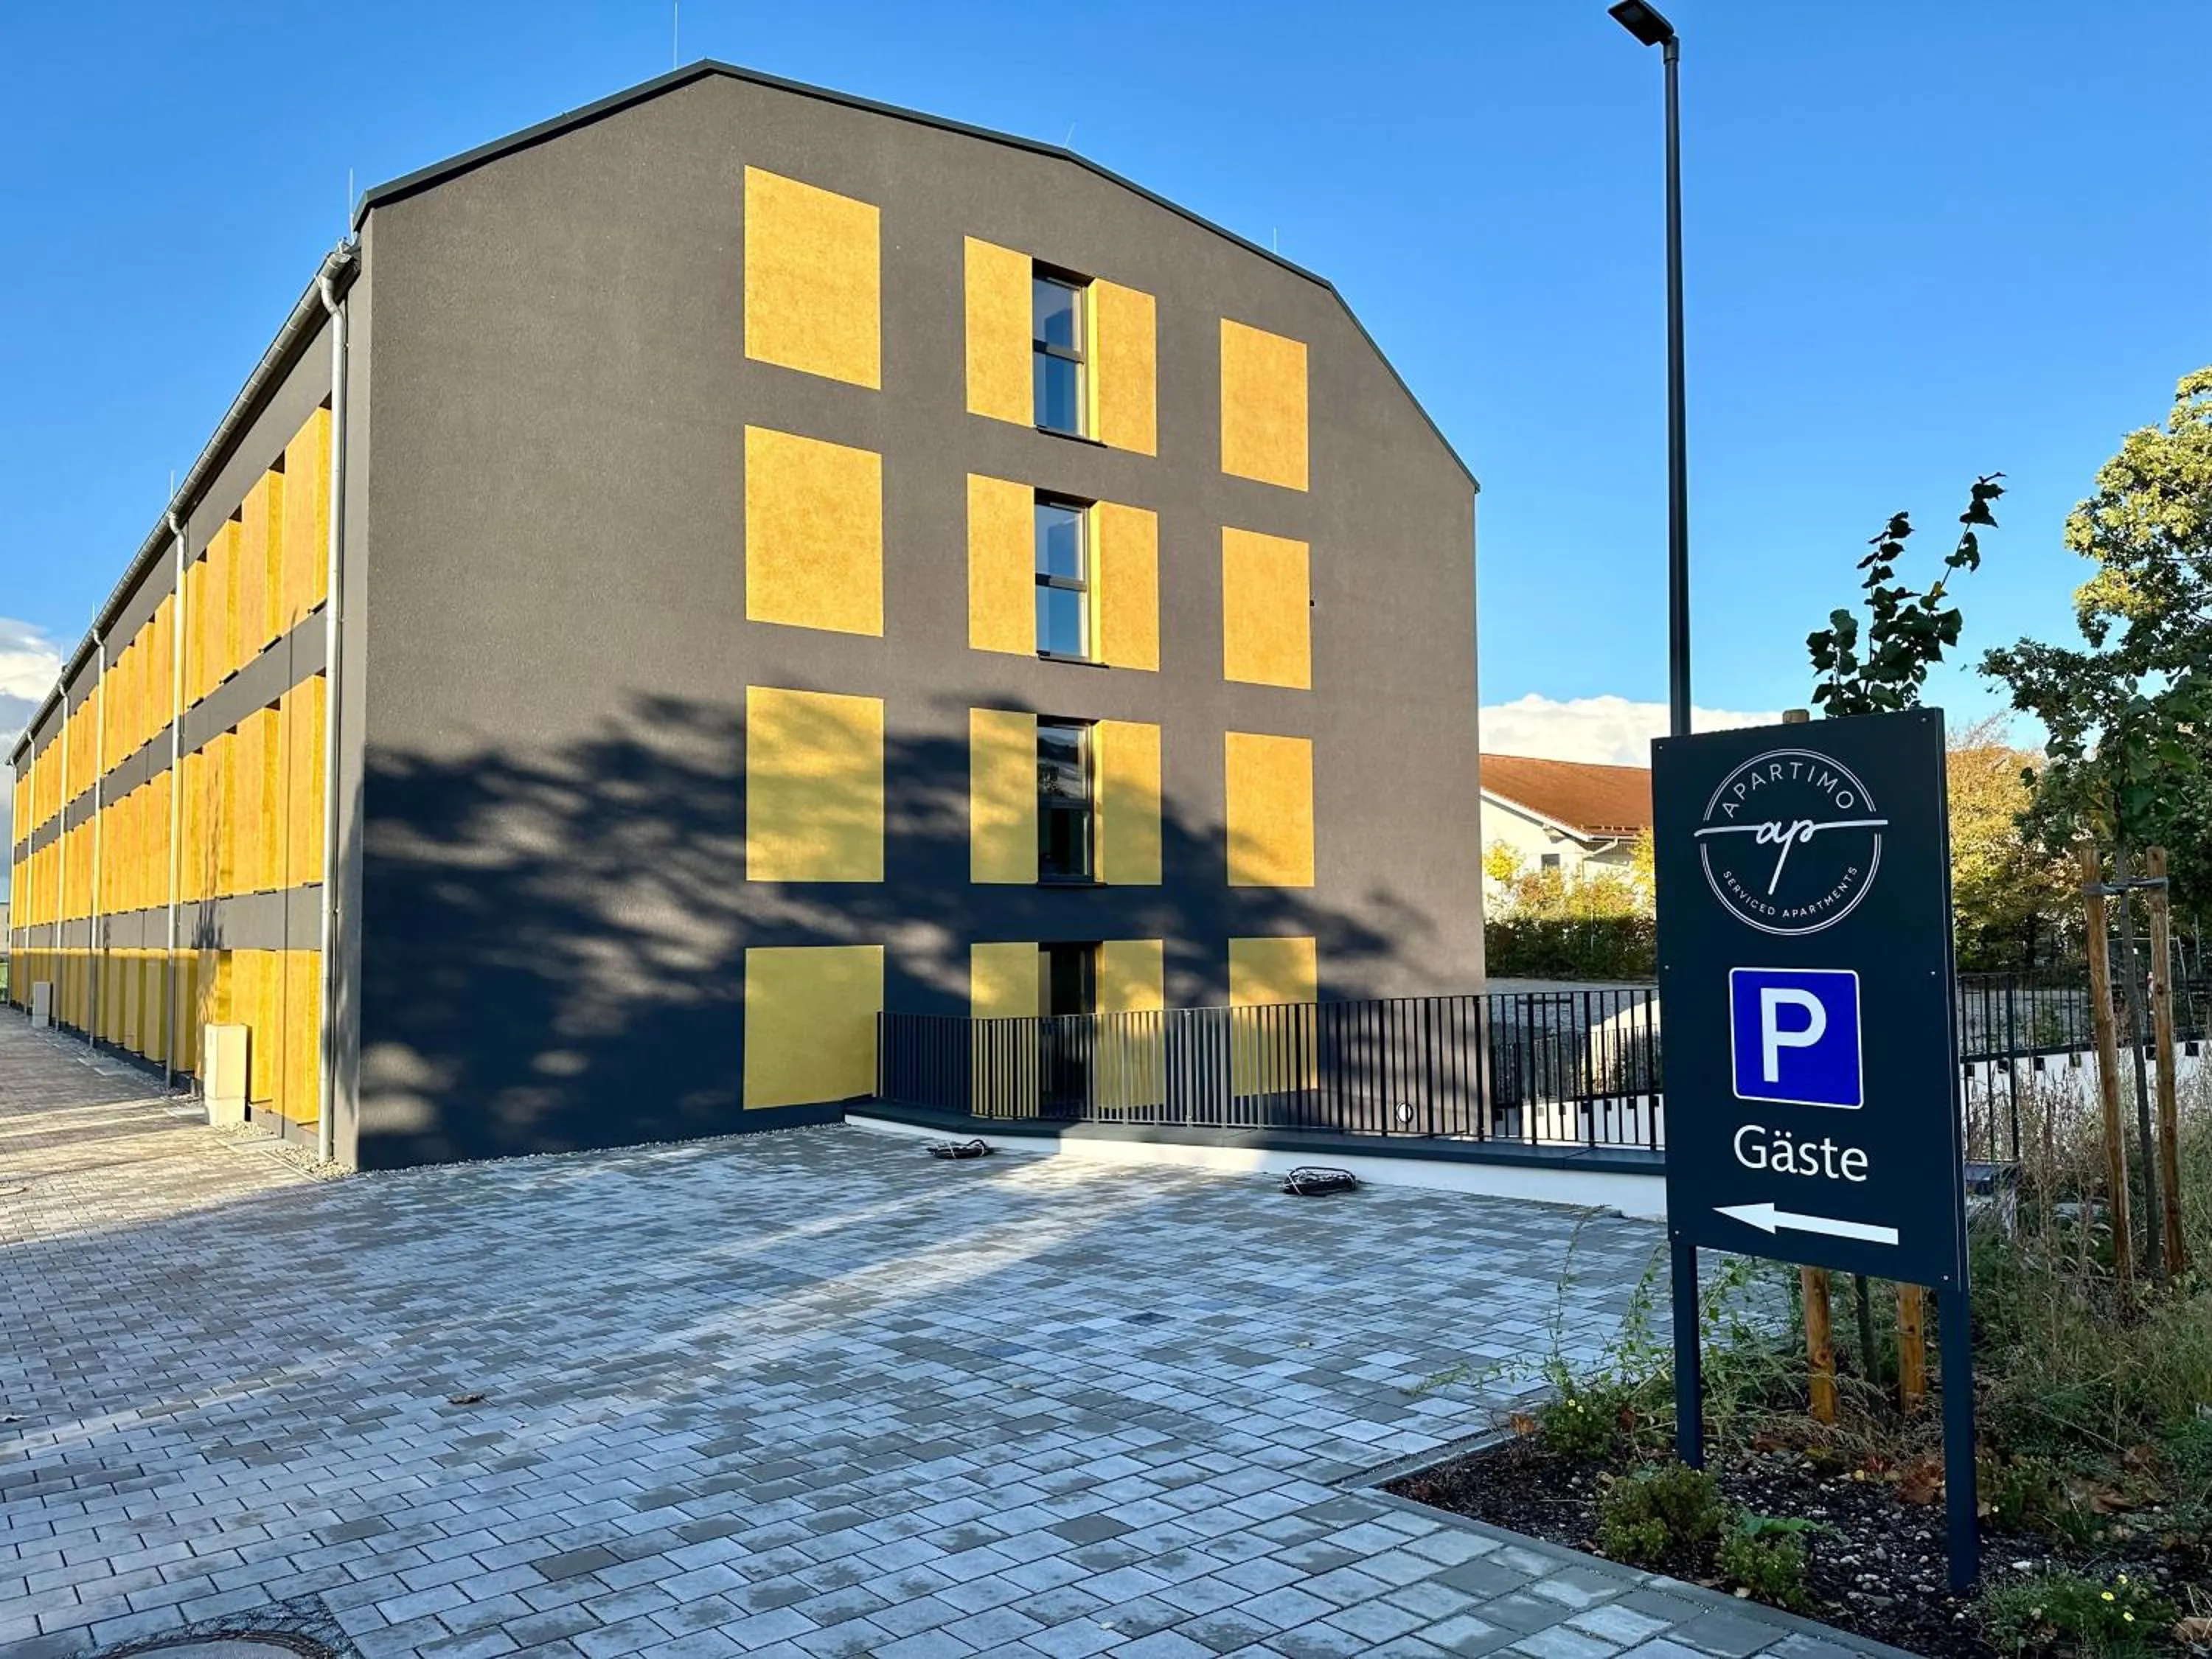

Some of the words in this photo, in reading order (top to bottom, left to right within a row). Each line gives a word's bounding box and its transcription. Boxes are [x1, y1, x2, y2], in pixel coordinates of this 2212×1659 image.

[1722, 762, 1855, 818] APARTIMO
[1723, 870, 1776, 917] SERVICED
[1781, 866, 1858, 919] APARTMENTS
[1759, 987, 1827, 1082] P
[1733, 1124, 1869, 1182] Gäste
